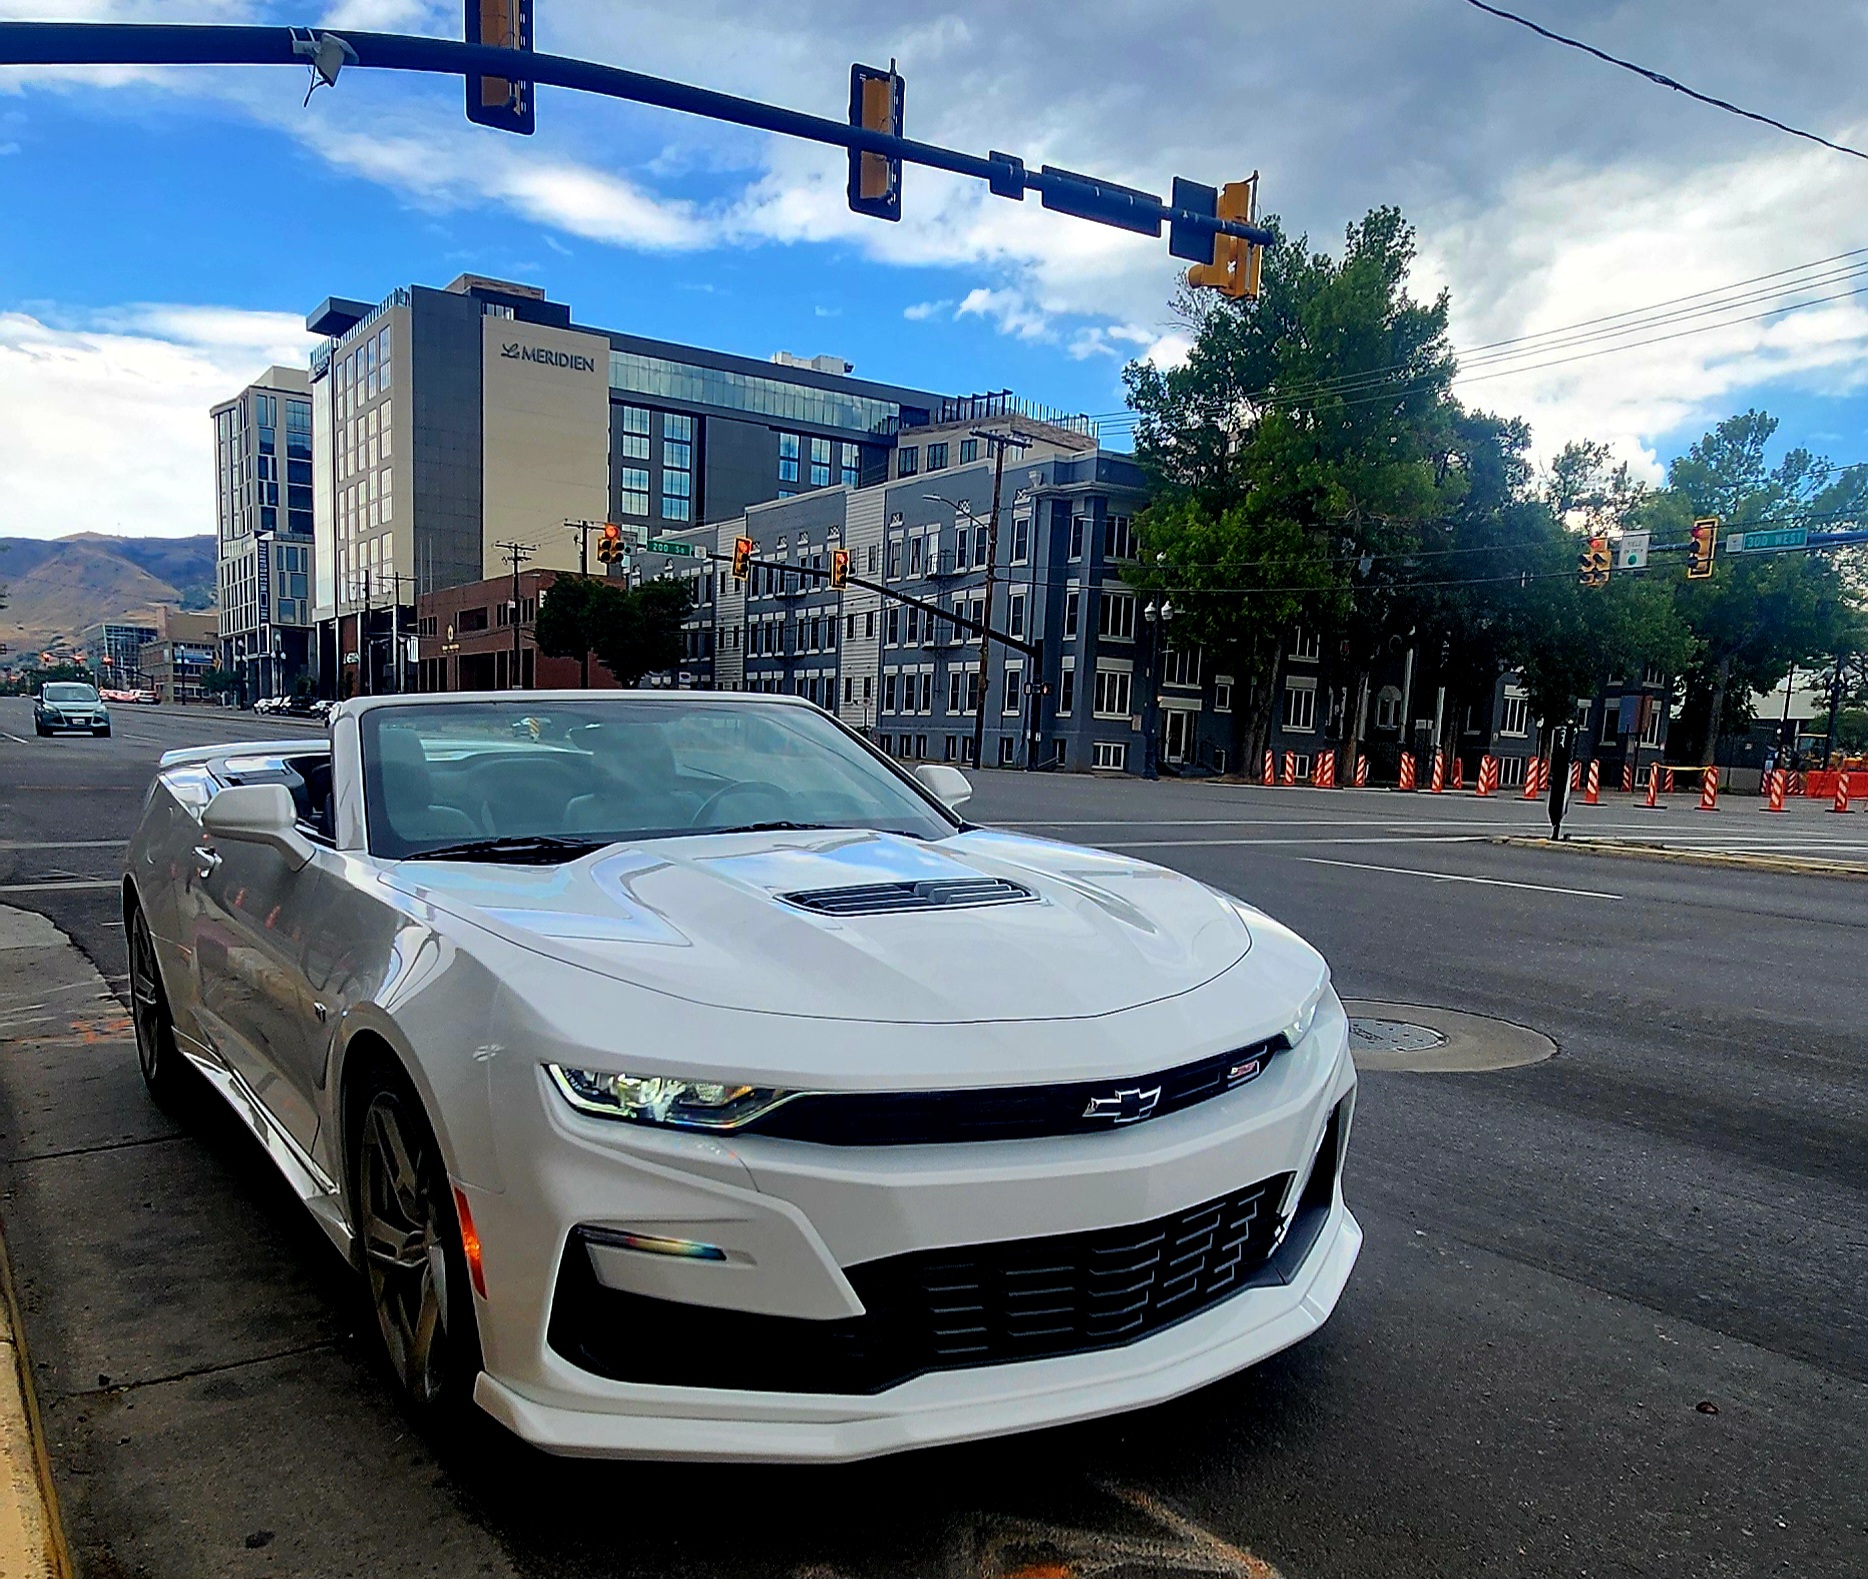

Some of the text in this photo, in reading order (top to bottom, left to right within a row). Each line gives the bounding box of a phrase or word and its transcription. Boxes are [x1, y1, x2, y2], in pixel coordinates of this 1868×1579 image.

[521, 345, 595, 372] MERIDIEN
[653, 542, 669, 553] 200
[1747, 532, 1803, 548] 300 WEST
